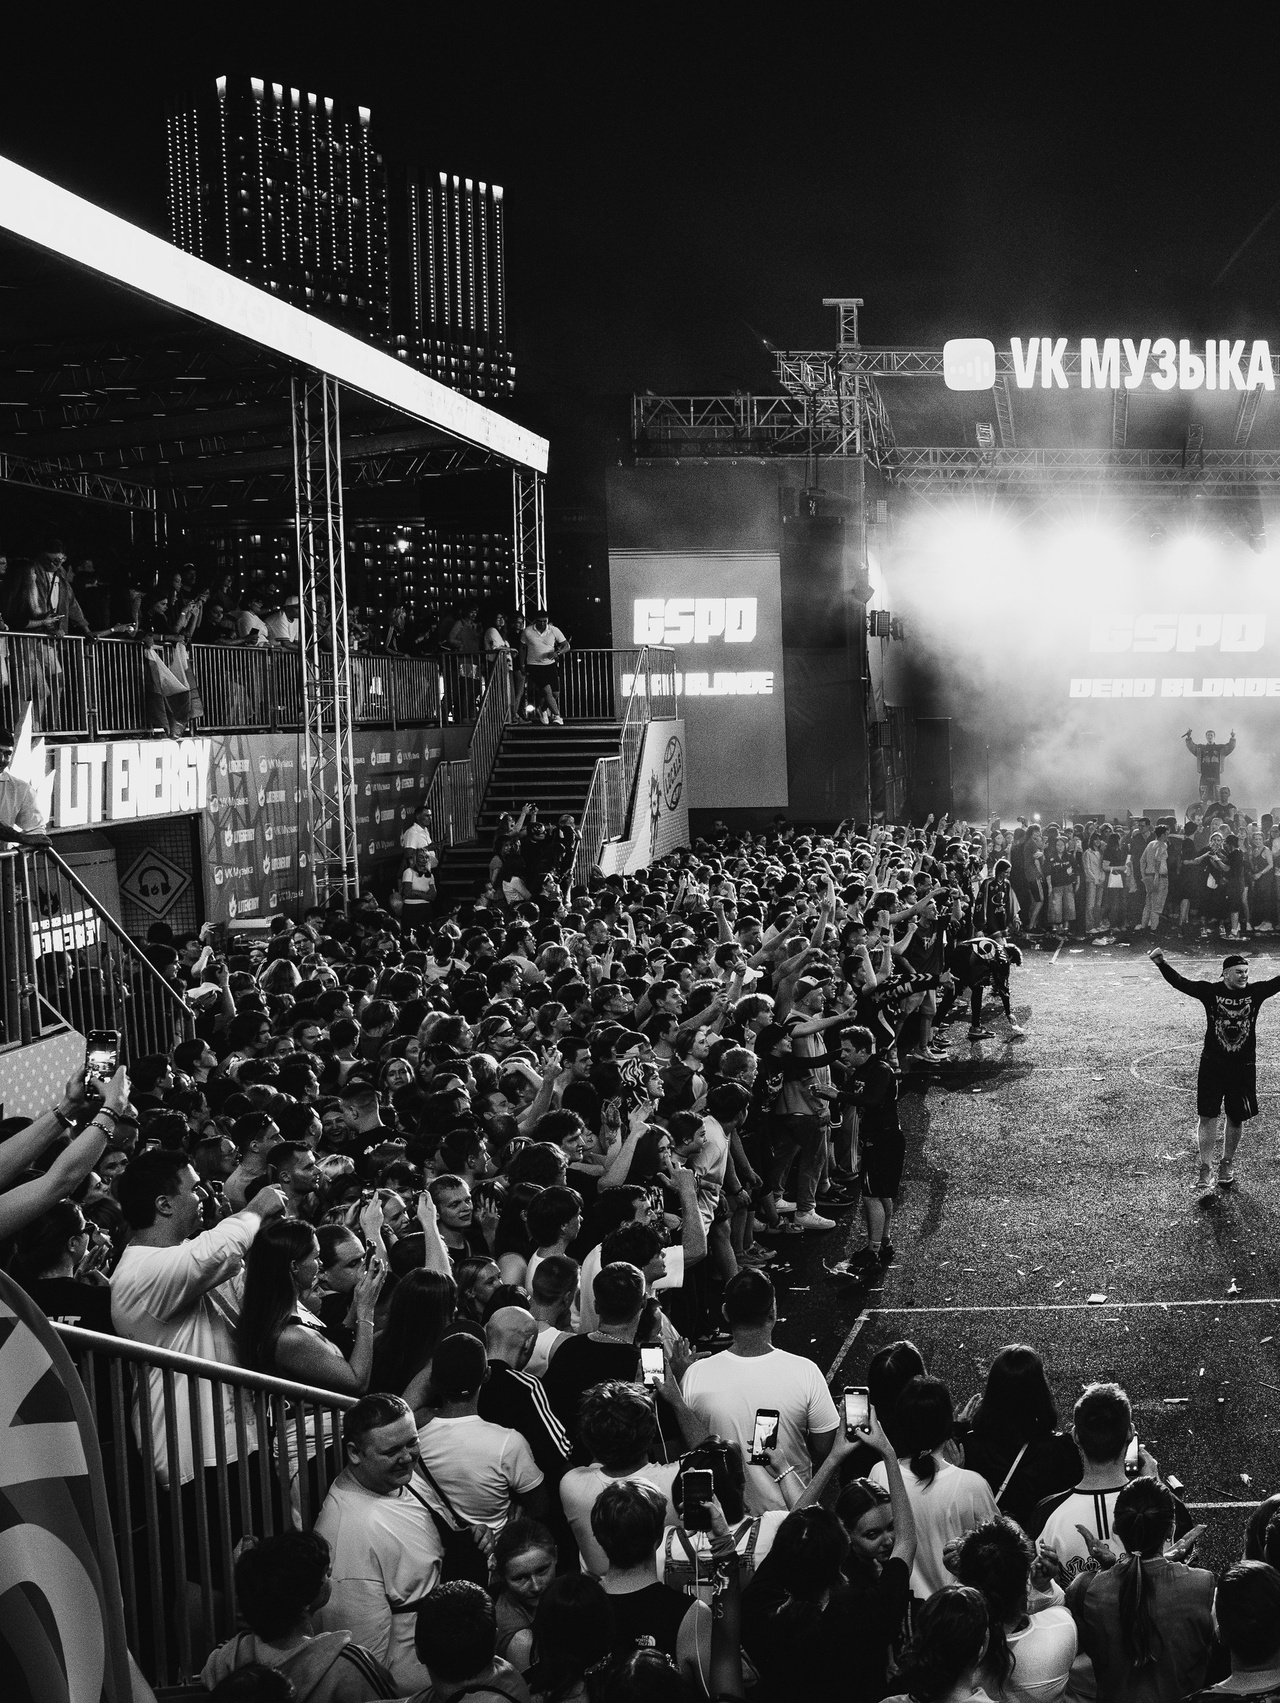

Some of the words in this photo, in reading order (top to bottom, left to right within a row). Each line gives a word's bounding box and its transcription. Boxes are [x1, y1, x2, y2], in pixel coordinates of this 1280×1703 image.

[1010, 336, 1069, 389] VK
[1081, 337, 1275, 391] МУЗЫКА
[634, 597, 758, 644] GSPD
[1088, 613, 1267, 652] GSPD
[685, 671, 774, 696] BLONDE
[1069, 678, 1156, 698] DEAD
[112, 738, 212, 820] ENERGY
[1215, 995, 1253, 1005] WOLFS
